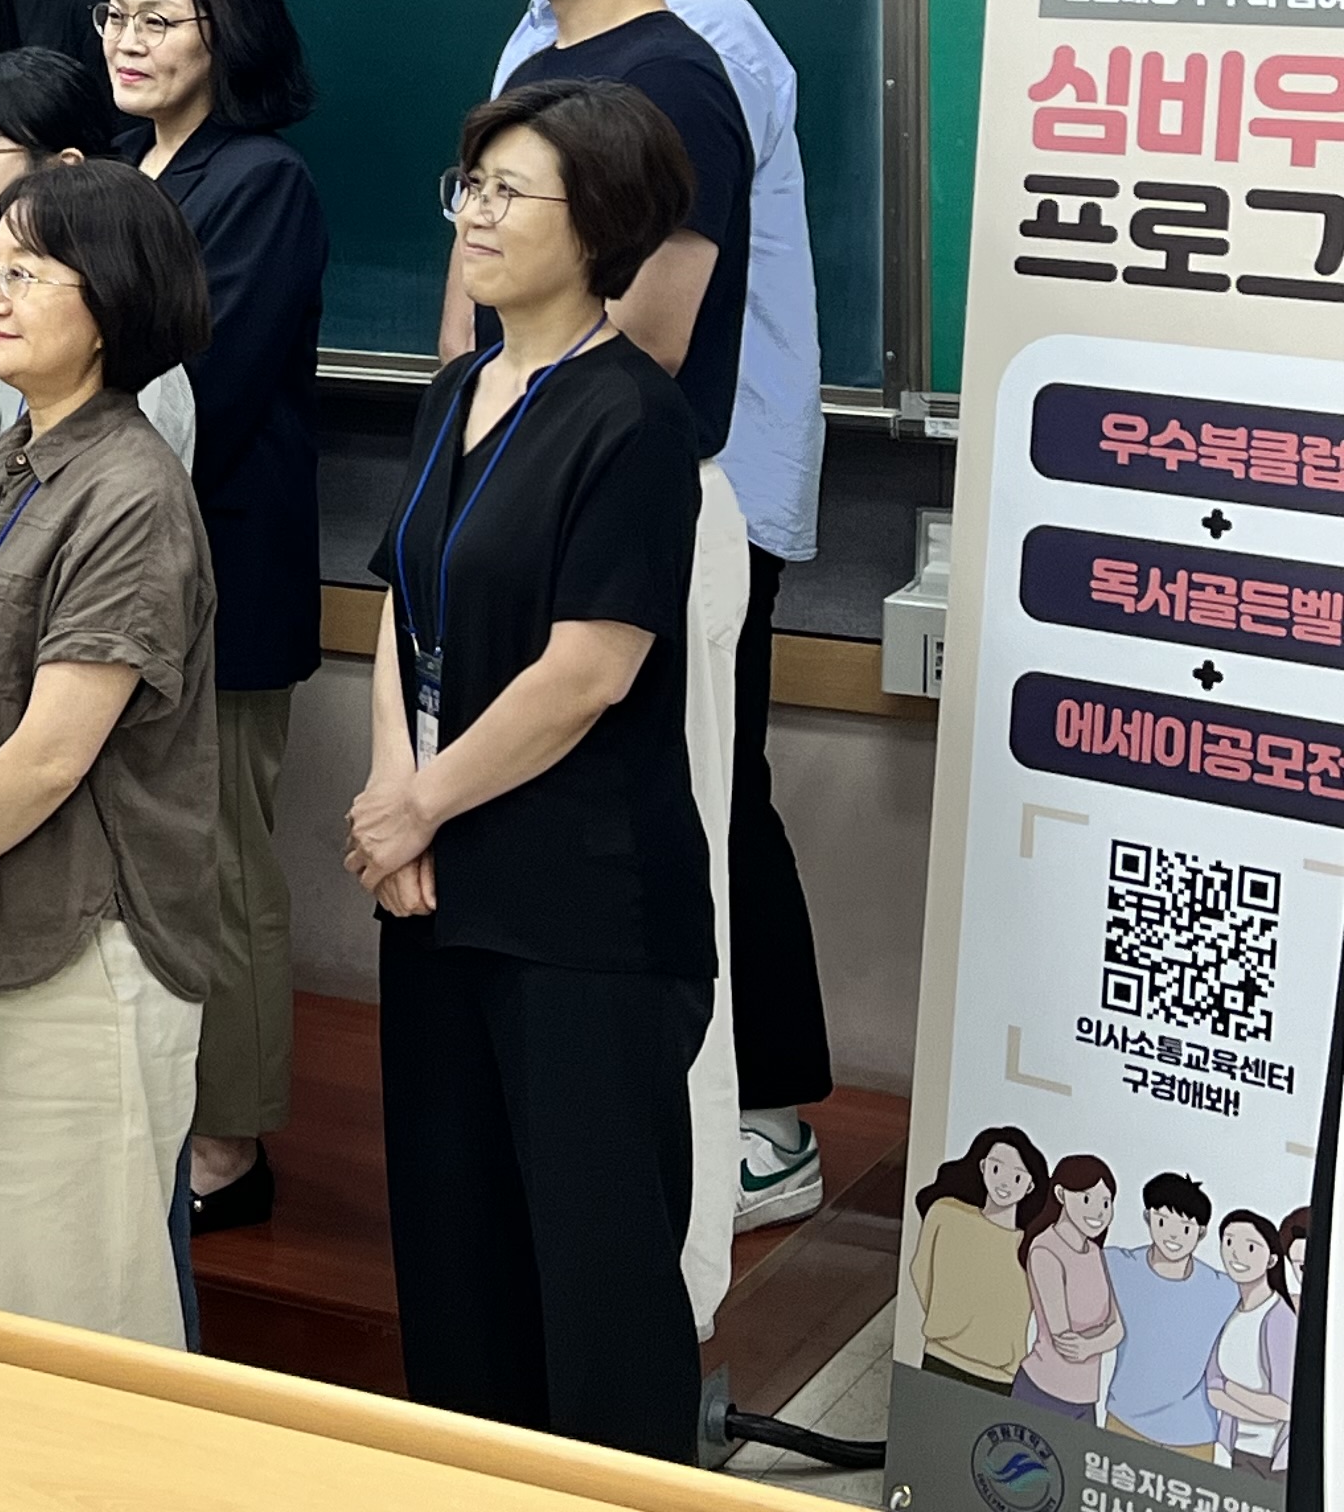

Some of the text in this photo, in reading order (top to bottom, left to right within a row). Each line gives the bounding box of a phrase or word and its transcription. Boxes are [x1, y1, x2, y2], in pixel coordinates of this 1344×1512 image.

[1099, 413, 1344, 493] 우수북클럽
[1089, 557, 1343, 646] 독서골든벨
[1055, 699, 1344, 801] 에세이공모전
[1075, 1016, 1295, 1094] 의사소통교육센터
[1123, 1063, 1241, 1117] 구경해봐!
